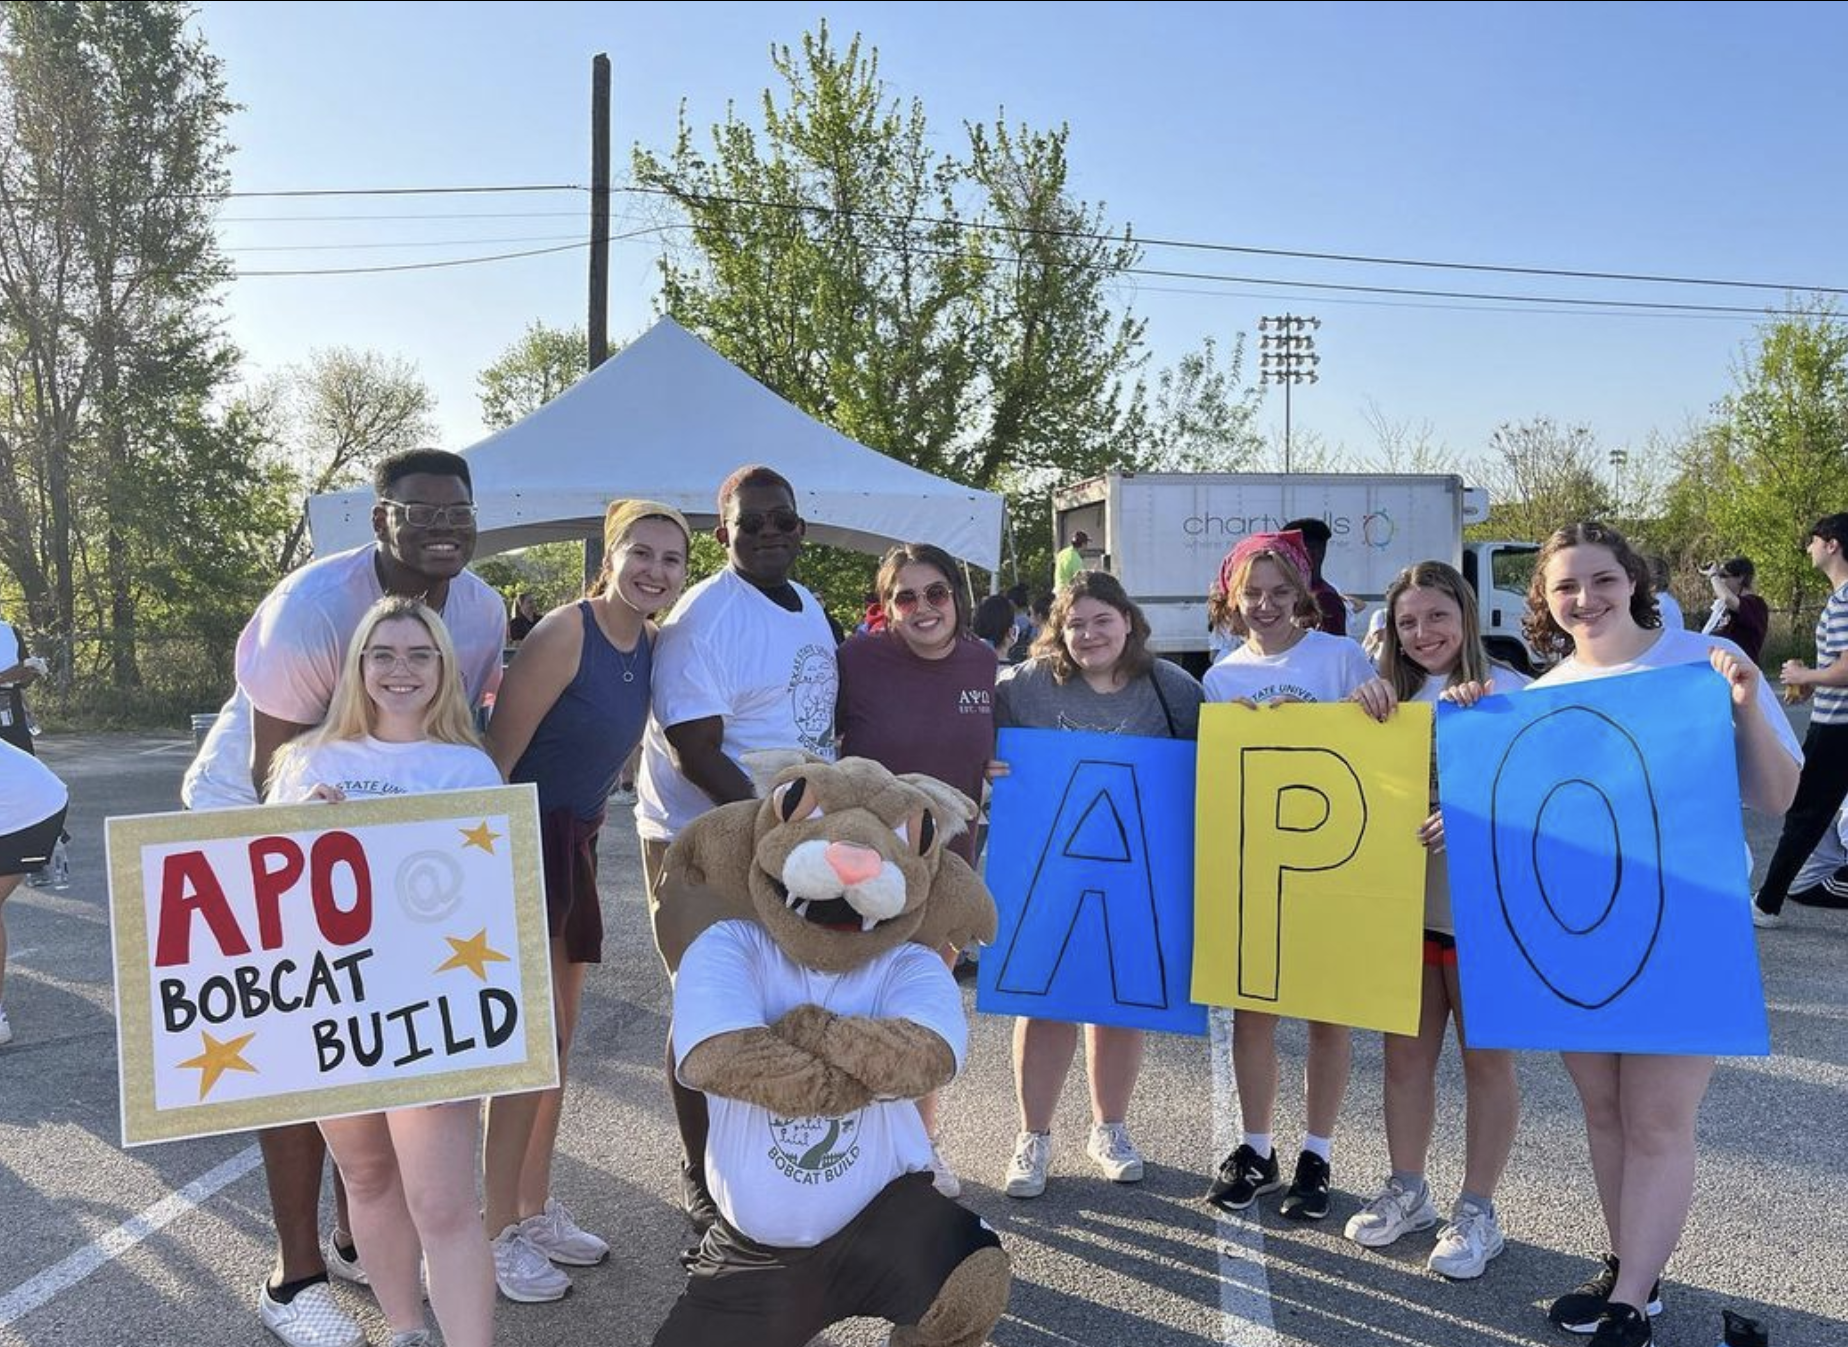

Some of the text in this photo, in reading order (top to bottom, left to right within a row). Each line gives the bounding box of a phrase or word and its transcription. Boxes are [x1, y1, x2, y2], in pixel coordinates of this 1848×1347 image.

[155, 830, 373, 967] APO
[159, 948, 374, 1033] BOBCAT
[312, 987, 519, 1073] BUILD
[768, 1146, 860, 1185] BOBCAT BUILD
